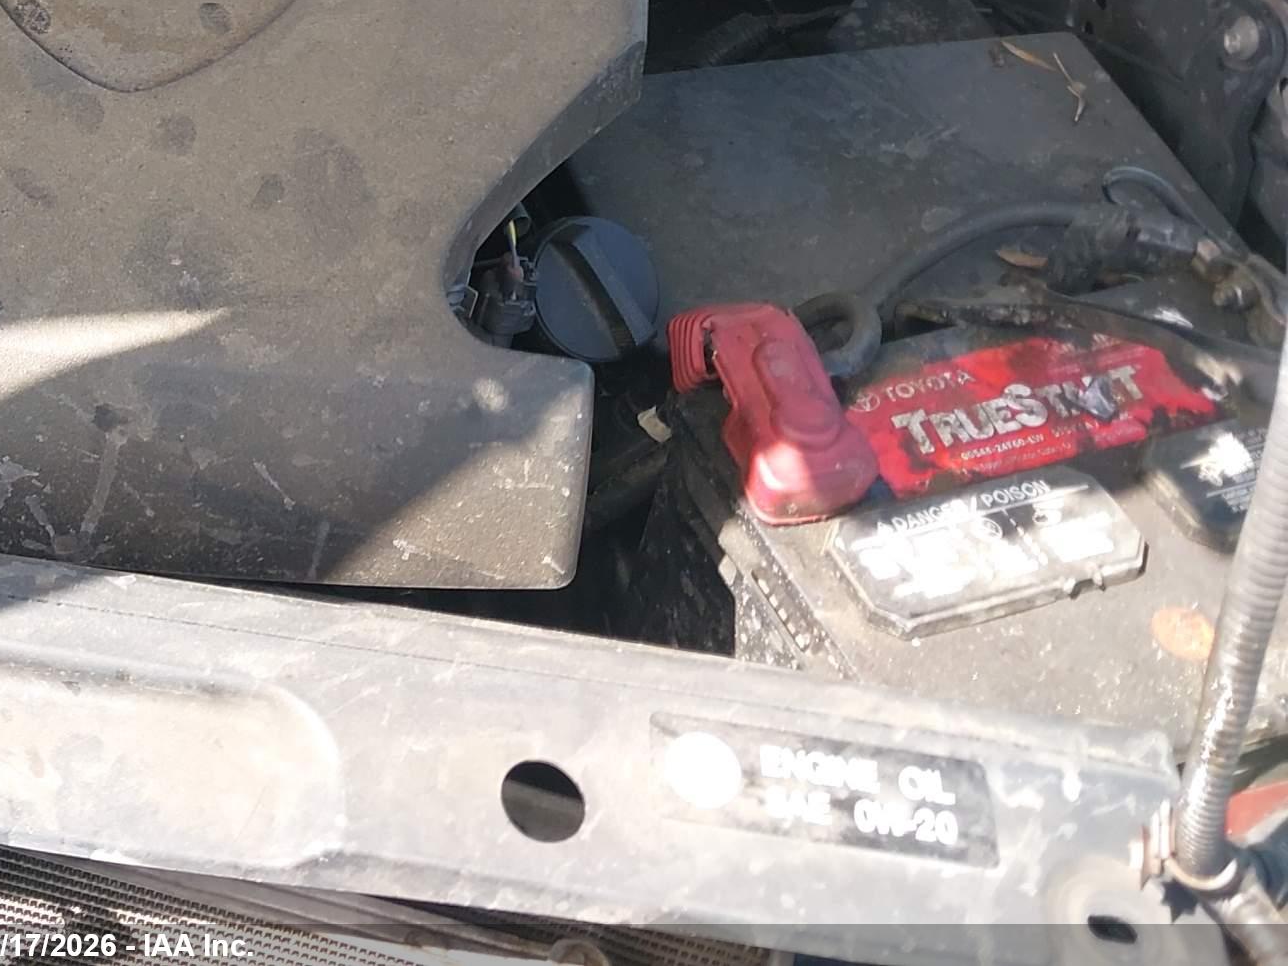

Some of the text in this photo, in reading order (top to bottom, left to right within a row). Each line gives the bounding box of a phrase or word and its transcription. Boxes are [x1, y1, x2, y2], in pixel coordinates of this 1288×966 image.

[886, 369, 976, 403] TOYOTA
[891, 365, 1144, 455] TRUESTAT
[980, 479, 1051, 508] POISON
[759, 744, 956, 805] ENGINE OIL
[764, 786, 959, 846] SAE 0W-20
